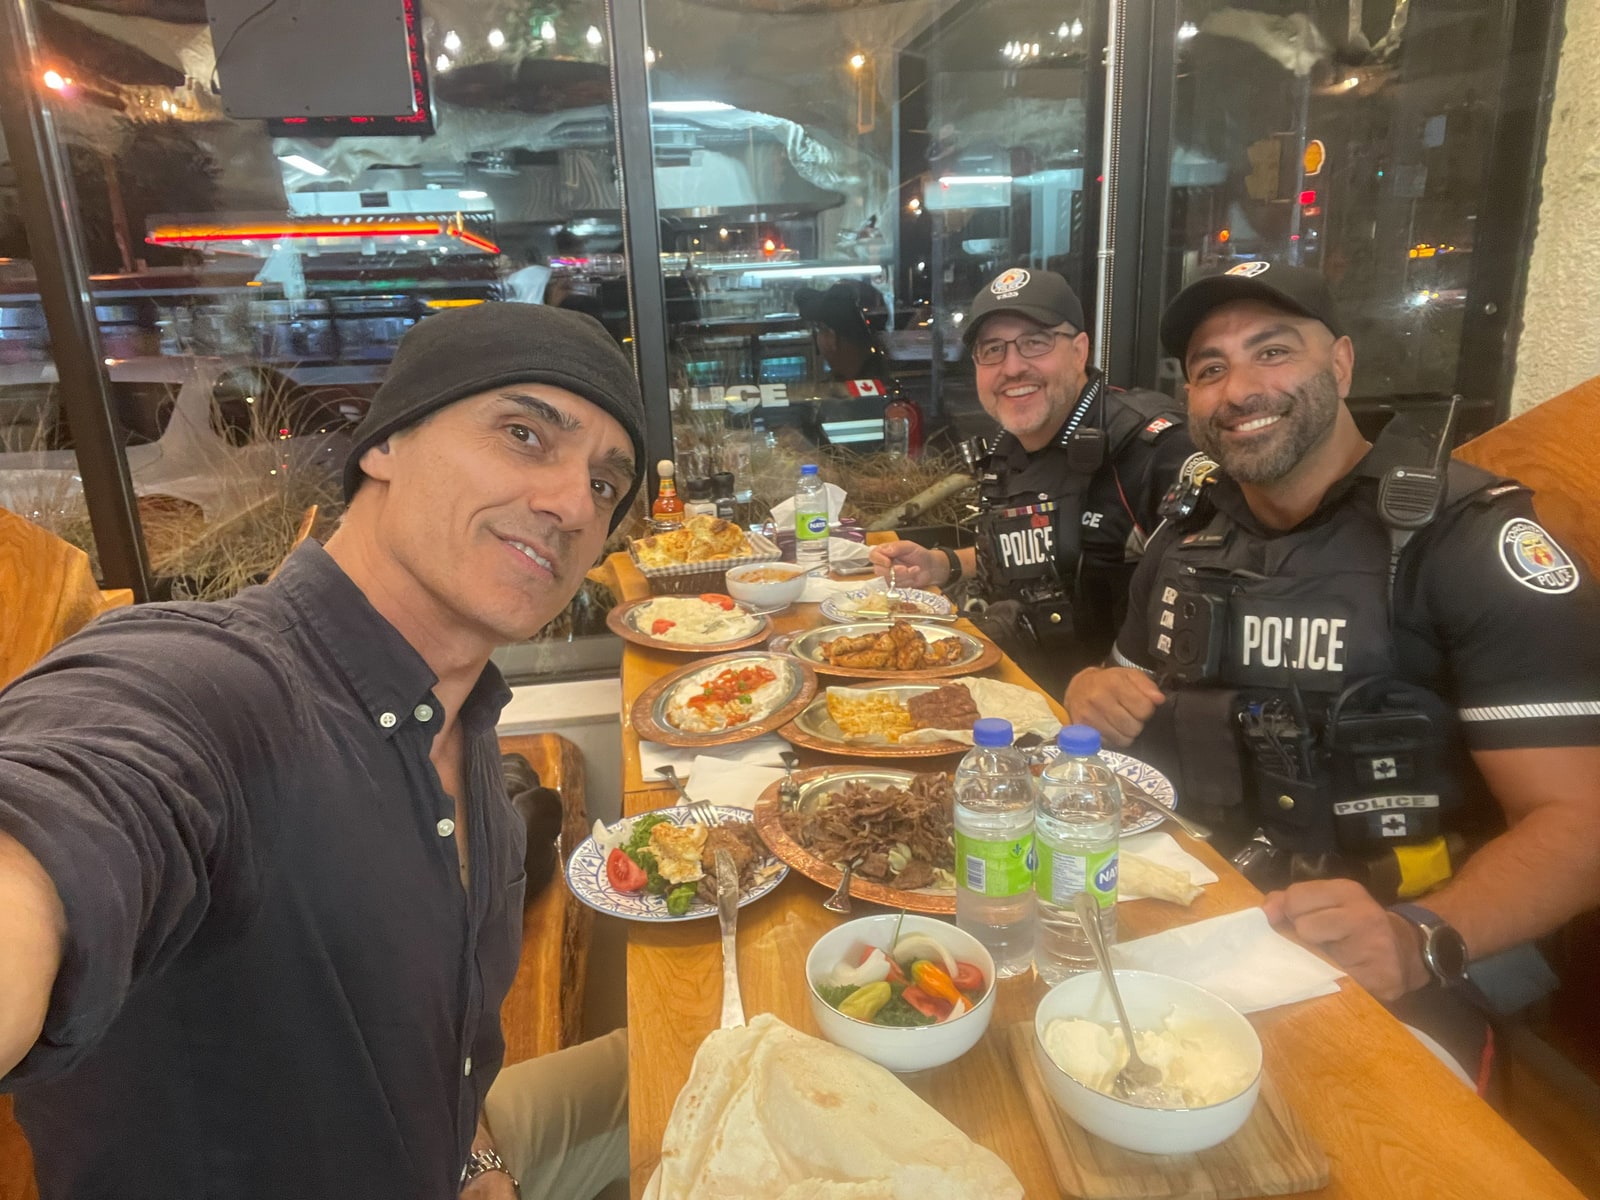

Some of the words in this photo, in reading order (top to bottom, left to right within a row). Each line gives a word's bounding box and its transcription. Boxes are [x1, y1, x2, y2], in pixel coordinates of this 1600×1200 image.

[1184, 455, 1209, 477] TORON
[1505, 523, 1542, 543] TORONT
[999, 526, 1055, 568] POLICE
[1537, 568, 1573, 587] POLICE
[1243, 615, 1347, 672] POLICE
[1336, 797, 1425, 813] POLICE
